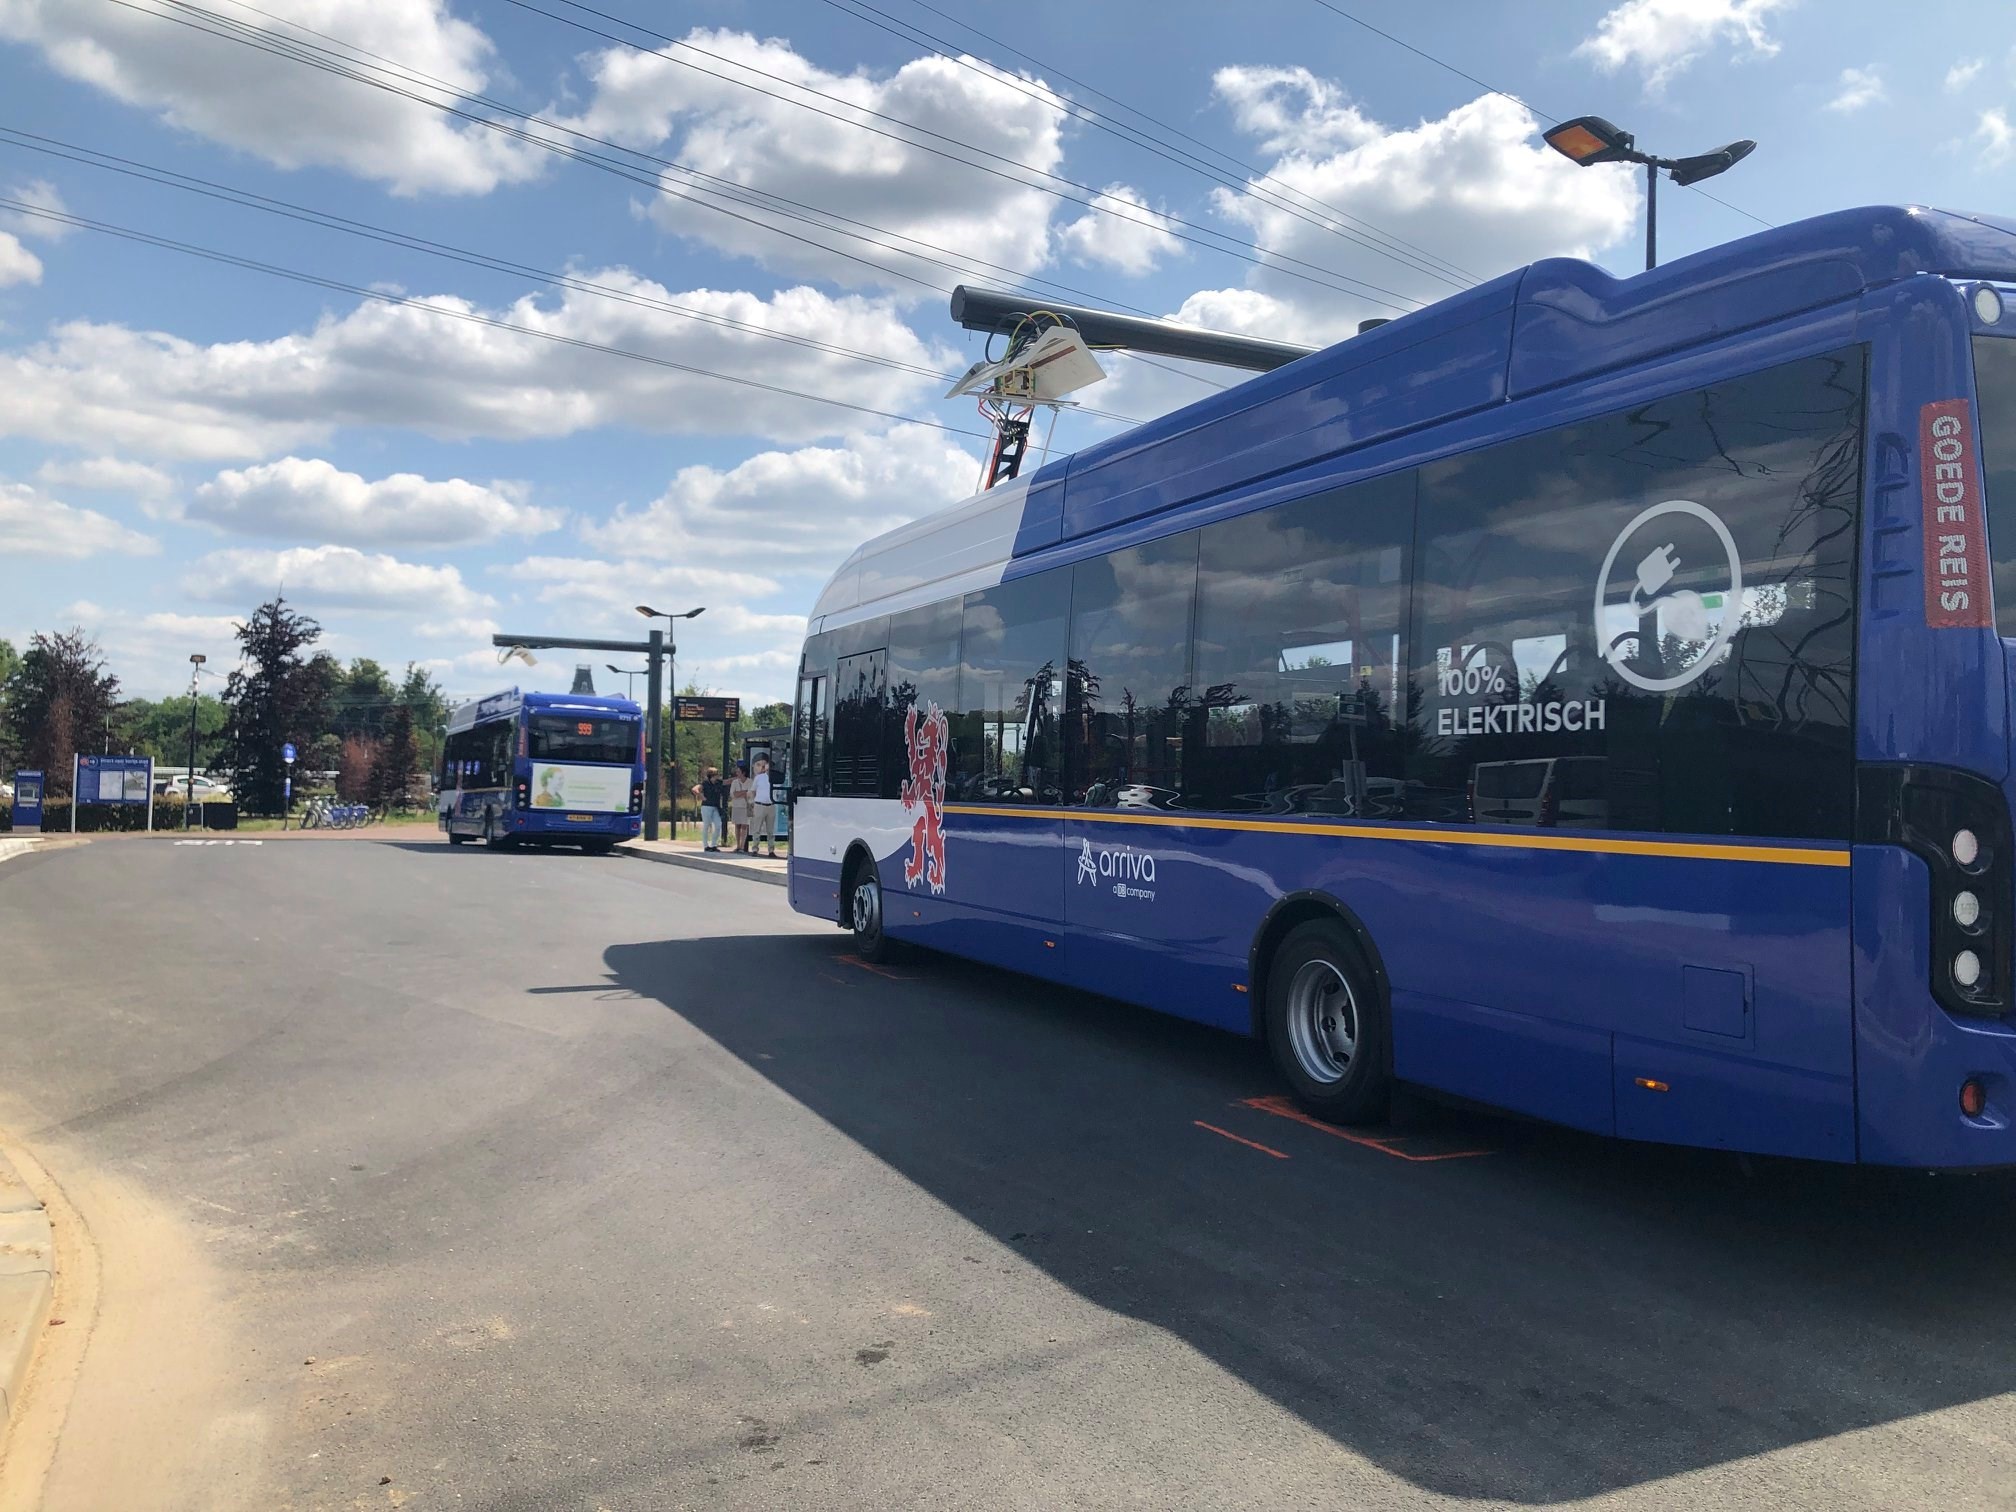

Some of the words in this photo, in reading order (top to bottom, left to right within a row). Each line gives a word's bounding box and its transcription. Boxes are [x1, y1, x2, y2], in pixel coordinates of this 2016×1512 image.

[1931, 414, 1966, 524] GOEDE
[1938, 533, 1970, 612] REIS
[1437, 664, 1506, 697] 100%
[1437, 699, 1606, 736] ELEKTRISCH
[1099, 845, 1155, 882] arriva
[1117, 884, 1126, 897] DB
[1126, 888, 1155, 902] company
